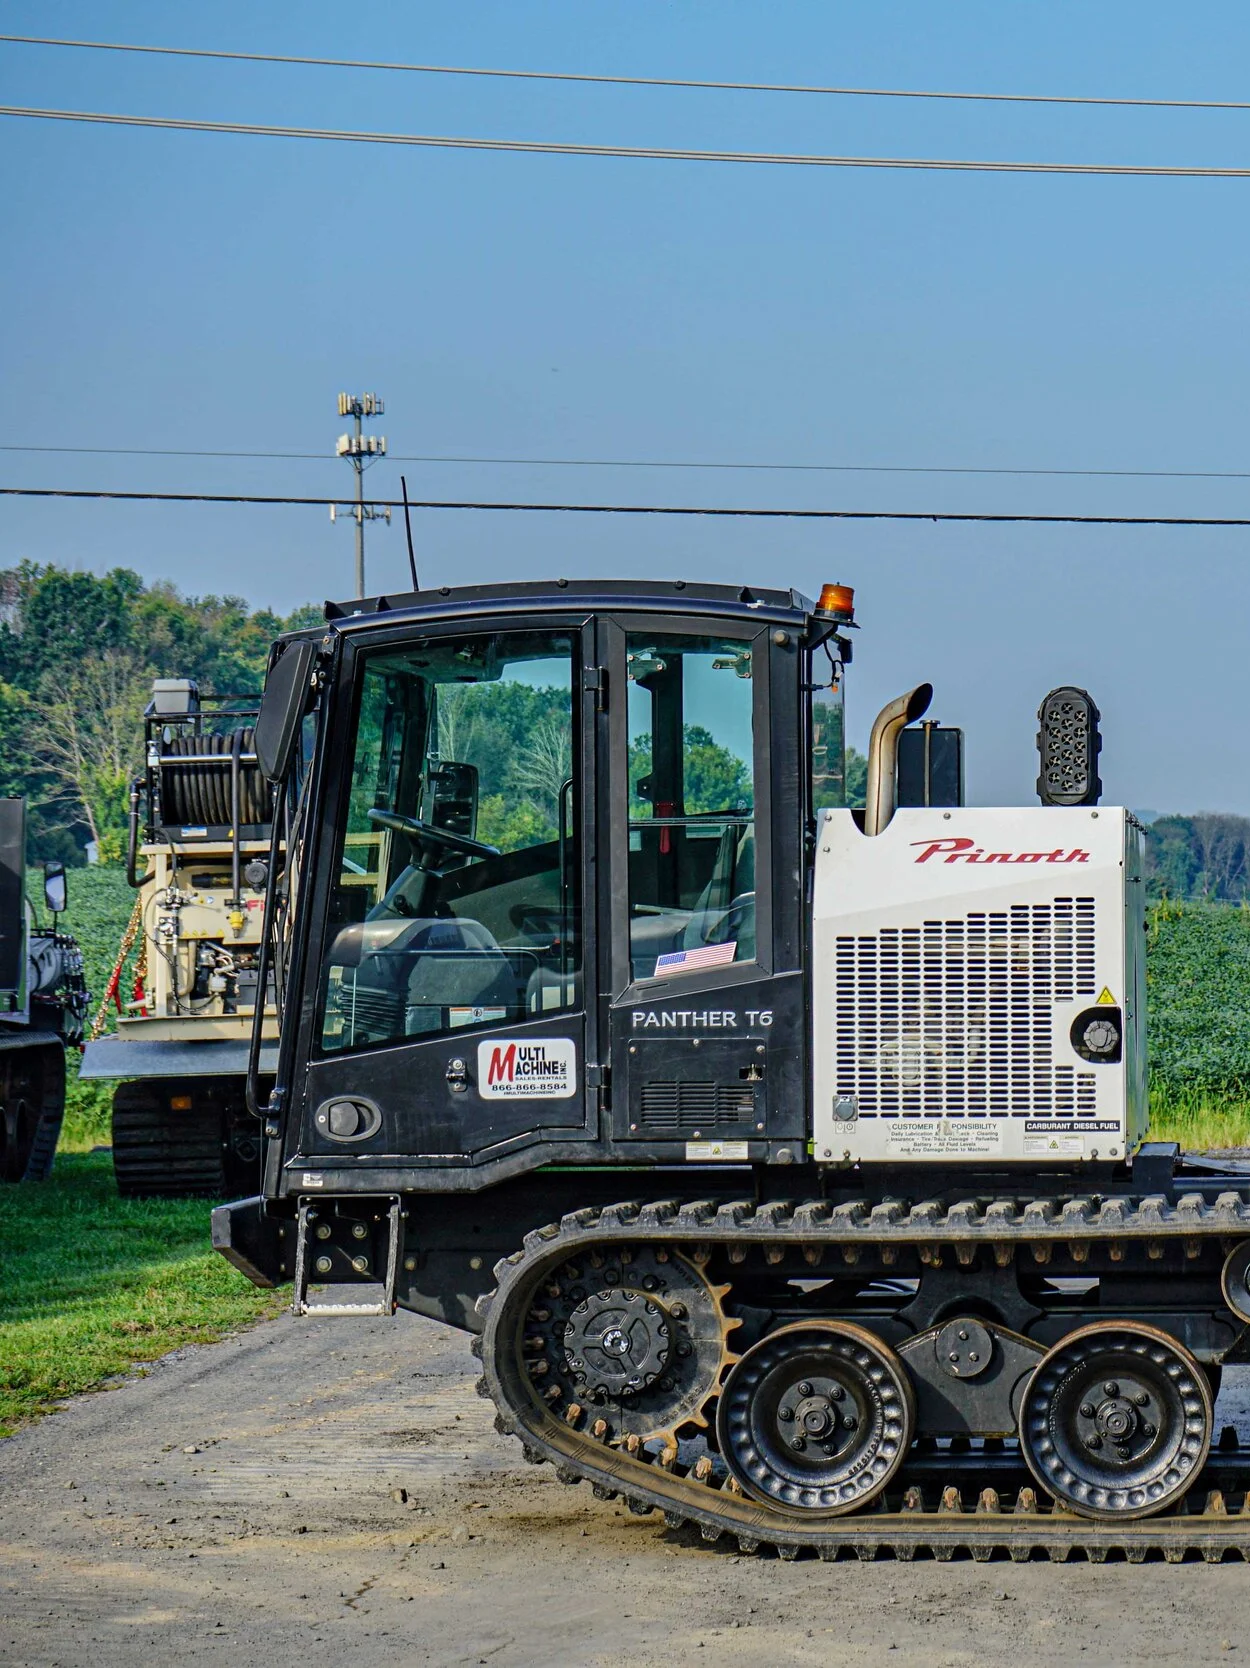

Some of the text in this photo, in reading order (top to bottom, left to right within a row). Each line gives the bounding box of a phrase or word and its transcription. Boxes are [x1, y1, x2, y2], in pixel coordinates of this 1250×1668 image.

[909, 838, 1091, 864] Prinoth
[632, 1011, 774, 1028] PANTHER T6
[491, 1083, 567, 1091] 866-866-8584
[1026, 1122, 1119, 1130] CARBURANT DIESEL FUEL
